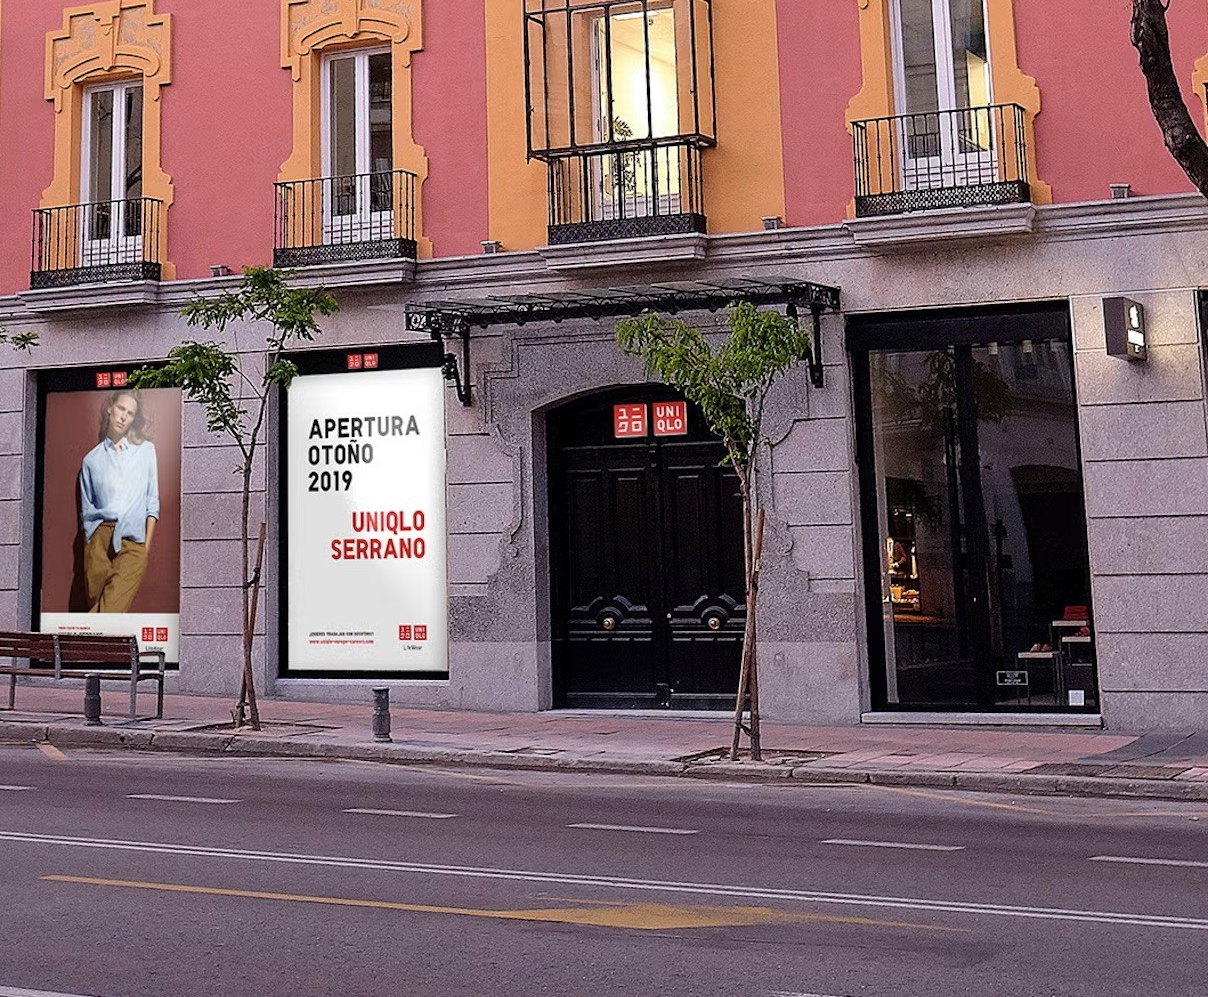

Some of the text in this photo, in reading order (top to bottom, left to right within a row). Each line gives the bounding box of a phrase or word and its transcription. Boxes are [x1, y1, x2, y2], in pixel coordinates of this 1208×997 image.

[308, 415, 420, 439] APERTURA
[308, 439, 373, 465] OTOÑO
[308, 470, 352, 492] 2019
[352, 510, 425, 535] UNIQLO
[331, 538, 425, 560] SERRANO
